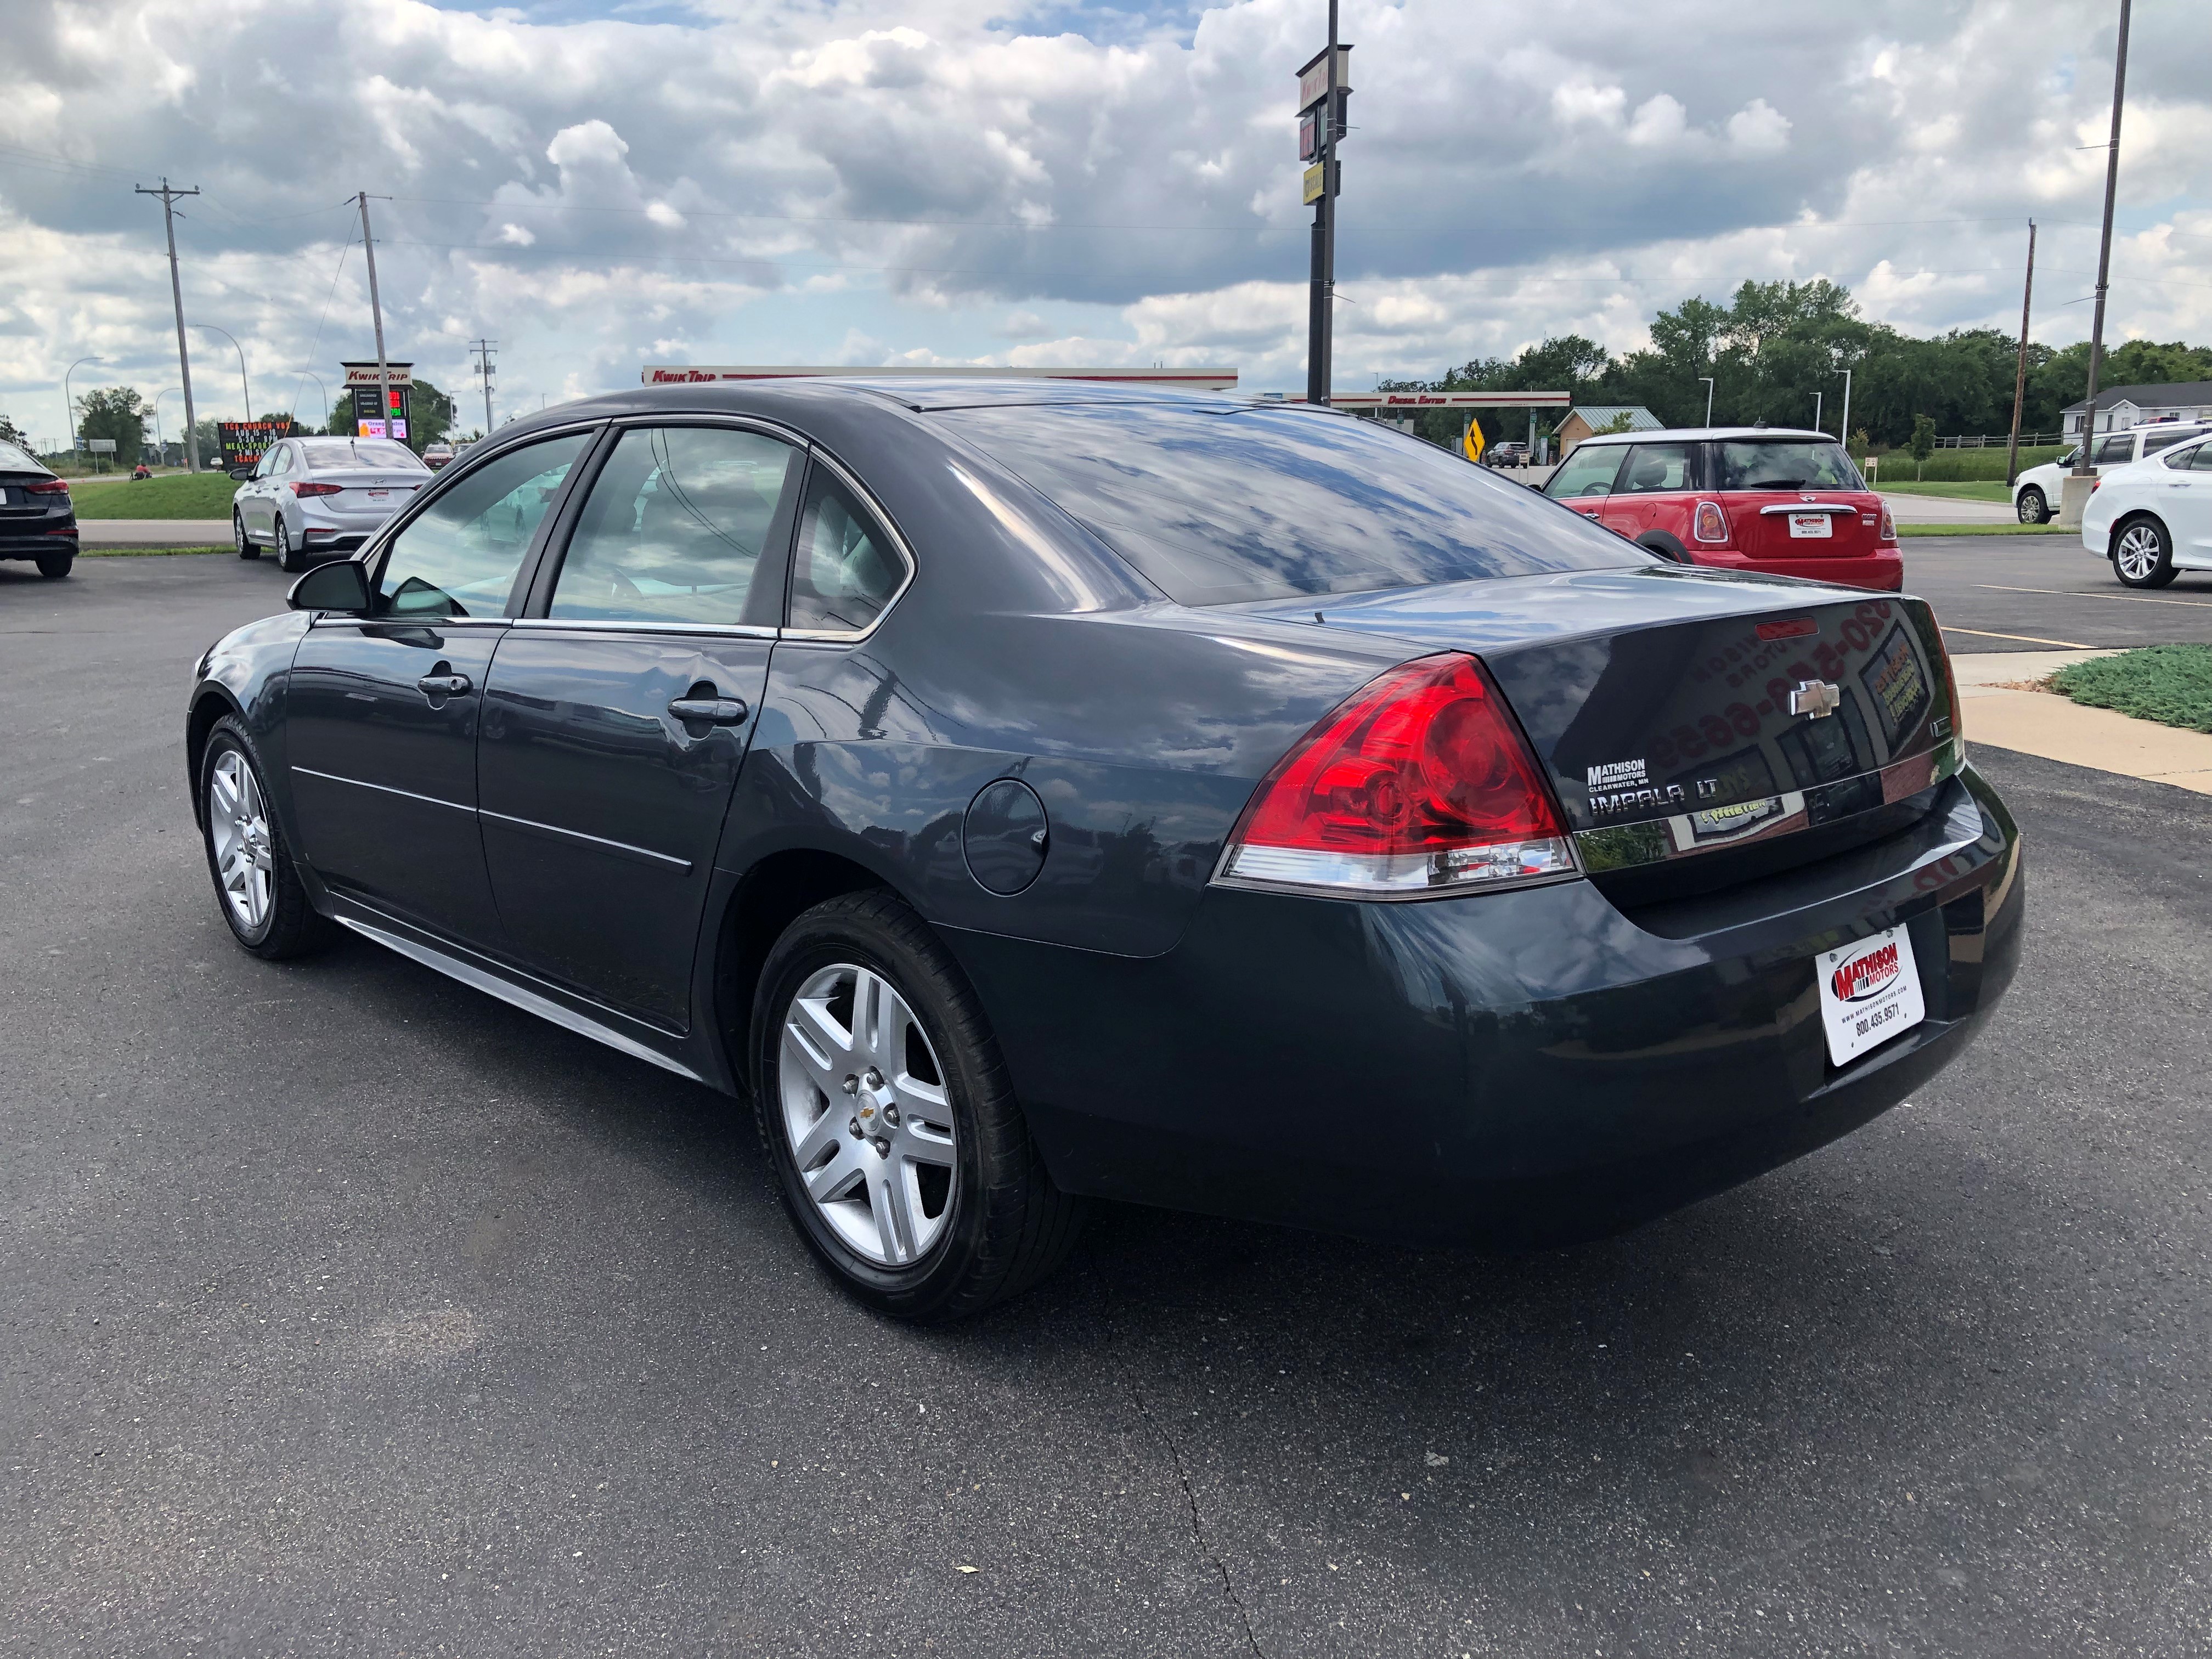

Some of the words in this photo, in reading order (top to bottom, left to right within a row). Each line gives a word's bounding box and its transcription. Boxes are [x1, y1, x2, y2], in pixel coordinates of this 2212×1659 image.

[348, 371, 380, 380] KWIK
[652, 370, 687, 382] KWIK
[689, 370, 716, 382] TRIP
[1388, 396, 1417, 404] DIESEL
[1418, 395, 1447, 404] ENTER
[1587, 759, 1645, 786] MATHISON
[1617, 770, 1646, 782] MOTORS
[1589, 781, 1638, 793] CLEARWATER,
[1589, 785, 1685, 816] IMPALA
[1696, 779, 1717, 799] LT
[1835, 943, 1898, 1001] MATHISON
[1869, 962, 1899, 986] MOTORS
[1842, 985, 1907, 1024] WWW.MATHISONMOTORS.COM
[1856, 1002, 1900, 1036] 800.435.9571
